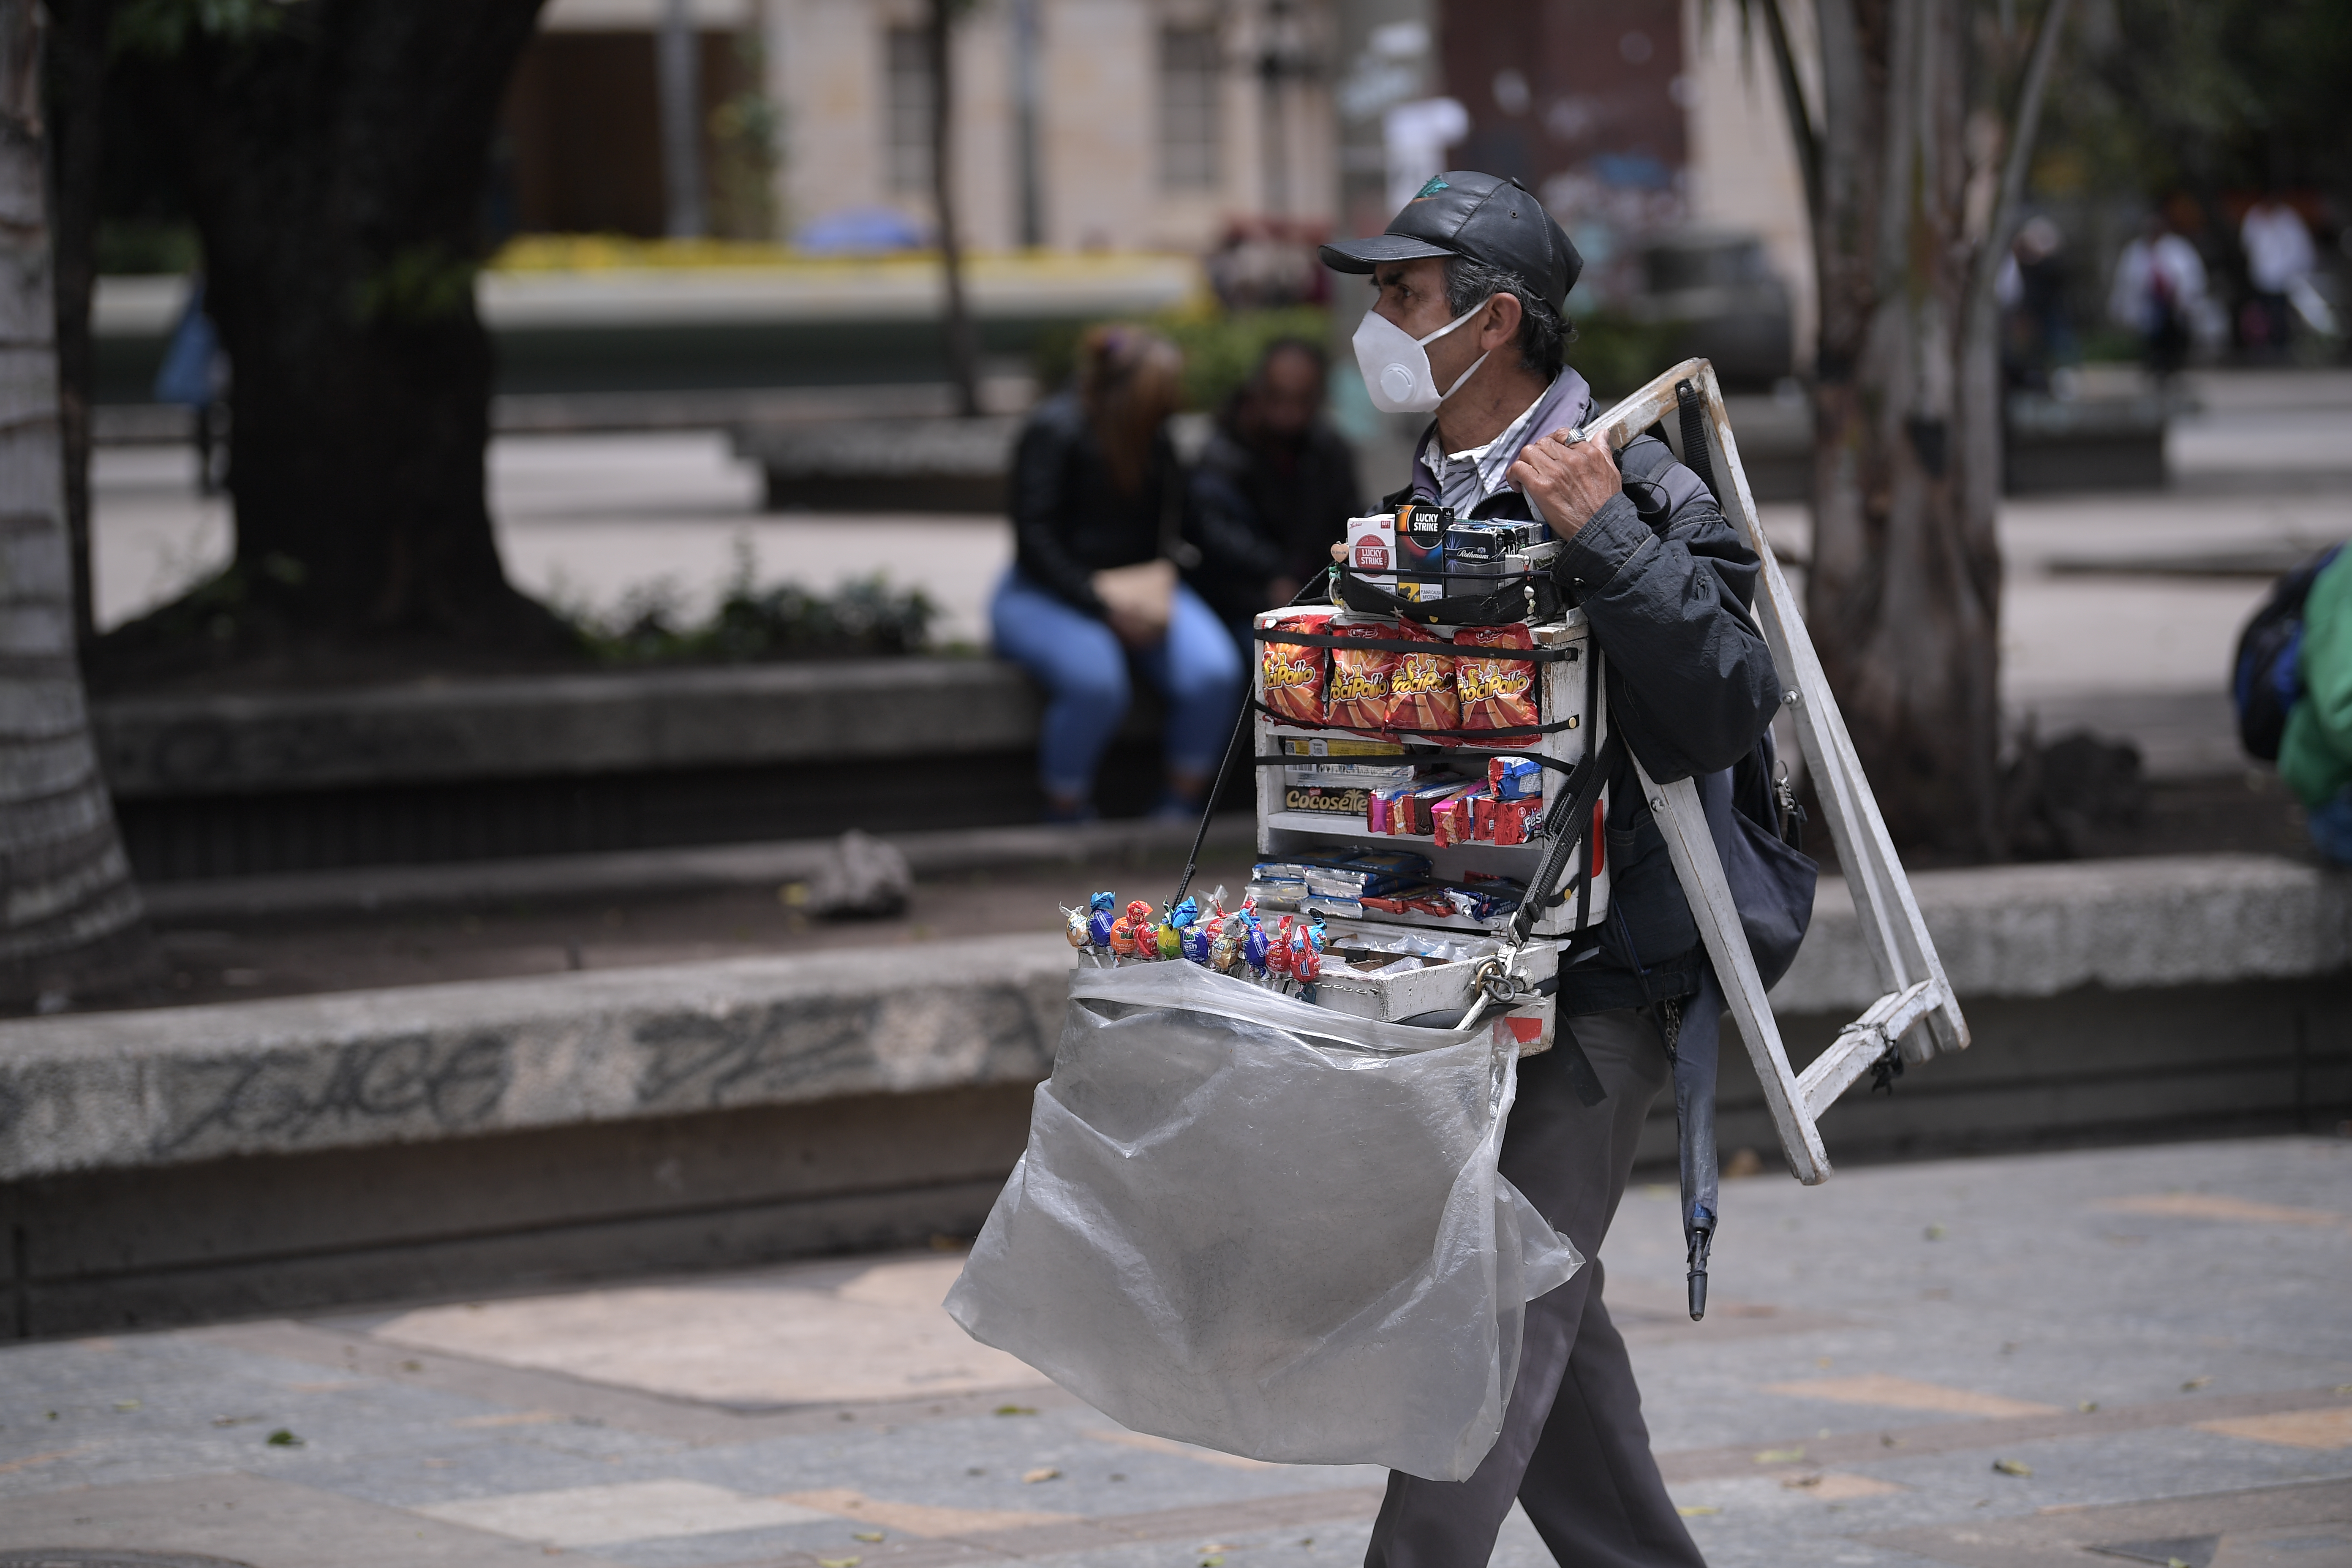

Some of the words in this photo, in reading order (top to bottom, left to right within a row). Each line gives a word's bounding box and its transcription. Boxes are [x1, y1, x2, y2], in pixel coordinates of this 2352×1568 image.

[1416, 513, 1439, 523] LUCKY
[1413, 522, 1438, 532] STRIKE
[1361, 549, 1382, 557] LUCKY
[1457, 549, 1489, 559] Rothmans
[1361, 556, 1383, 565] STRIKE
[1494, 903, 1516, 916] OREO
